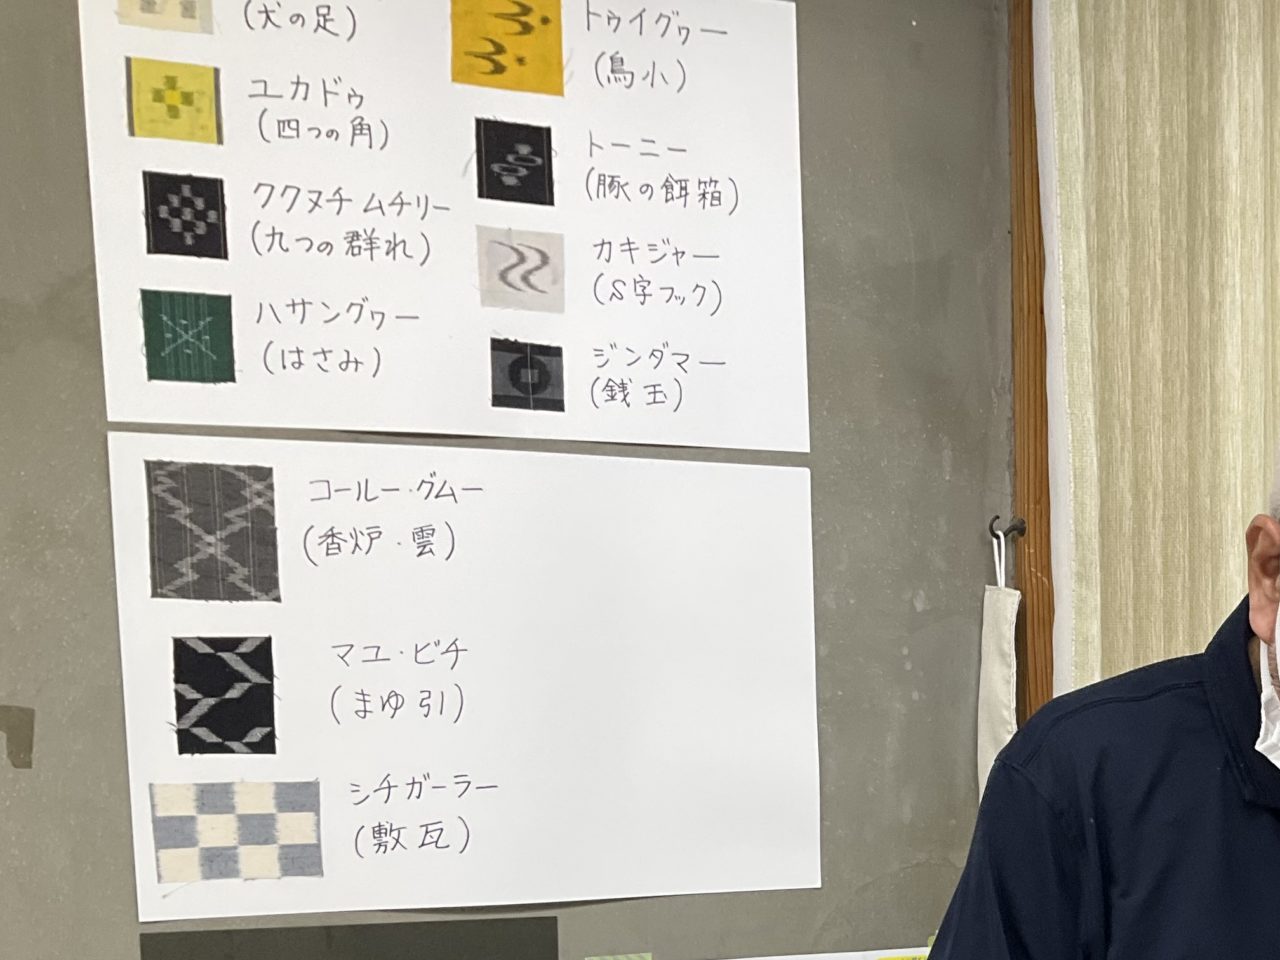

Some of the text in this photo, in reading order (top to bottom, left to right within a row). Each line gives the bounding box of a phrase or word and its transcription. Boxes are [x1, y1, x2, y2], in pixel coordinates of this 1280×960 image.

[258, 108, 389, 150] （四つの角）
[588, 130, 687, 157] トーニー
[585, 166, 739, 216] （豚の餌箱）
[251, 220, 431, 267] （九つの群れ）
[592, 237, 720, 267] カキジャー
[263, 340, 381, 378] （はさみ）
[592, 341, 726, 374] ジンダマー
[350, 771, 499, 806] シチガーラー
